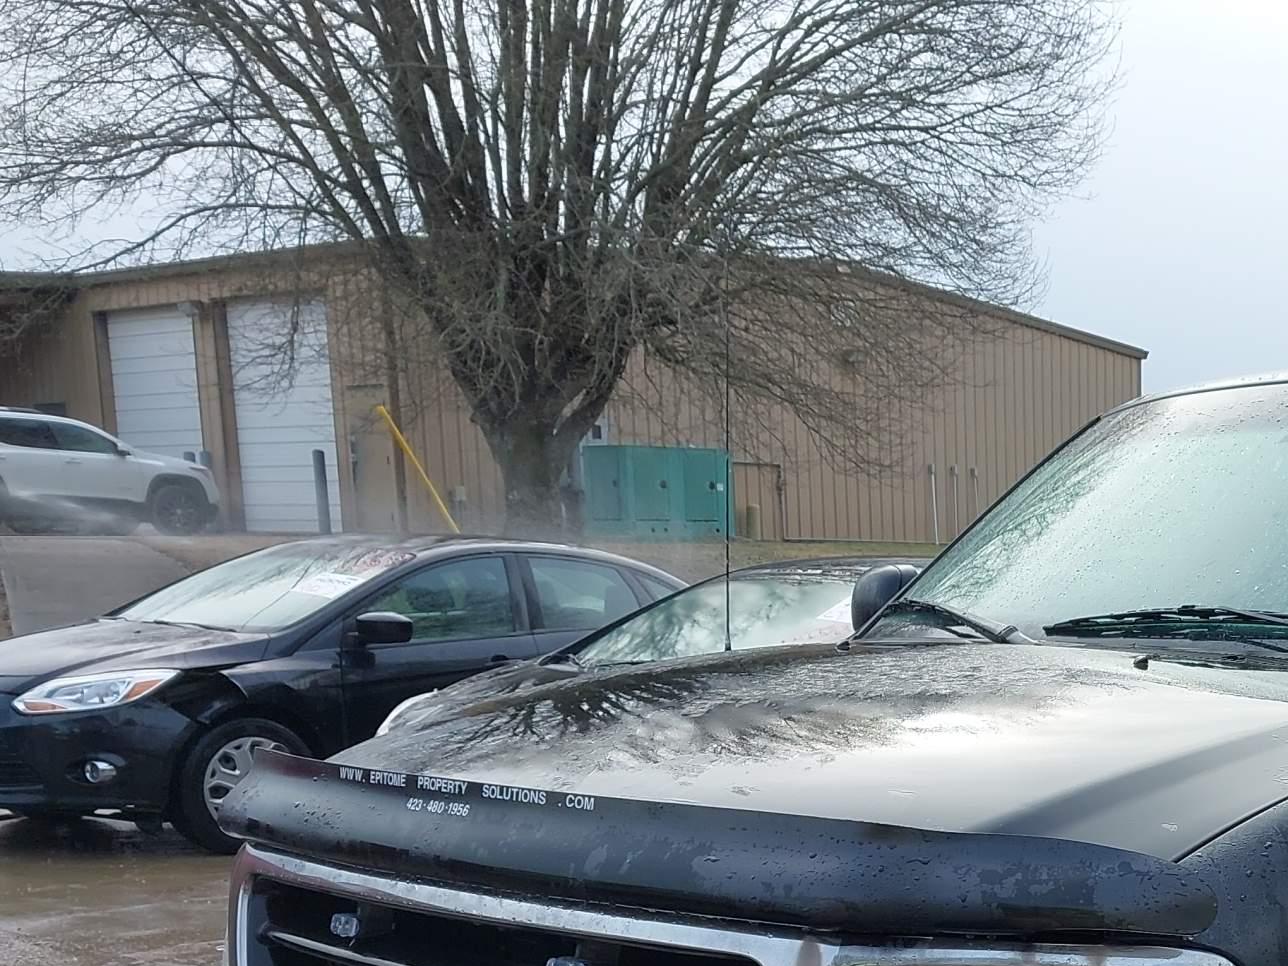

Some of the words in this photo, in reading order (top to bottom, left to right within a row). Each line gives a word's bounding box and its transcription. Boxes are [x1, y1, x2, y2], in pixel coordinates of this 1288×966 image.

[369, 769, 406, 788] EPITOME
[417, 775, 468, 795] PROPERTY
[481, 784, 547, 805] SOLUTIONS
